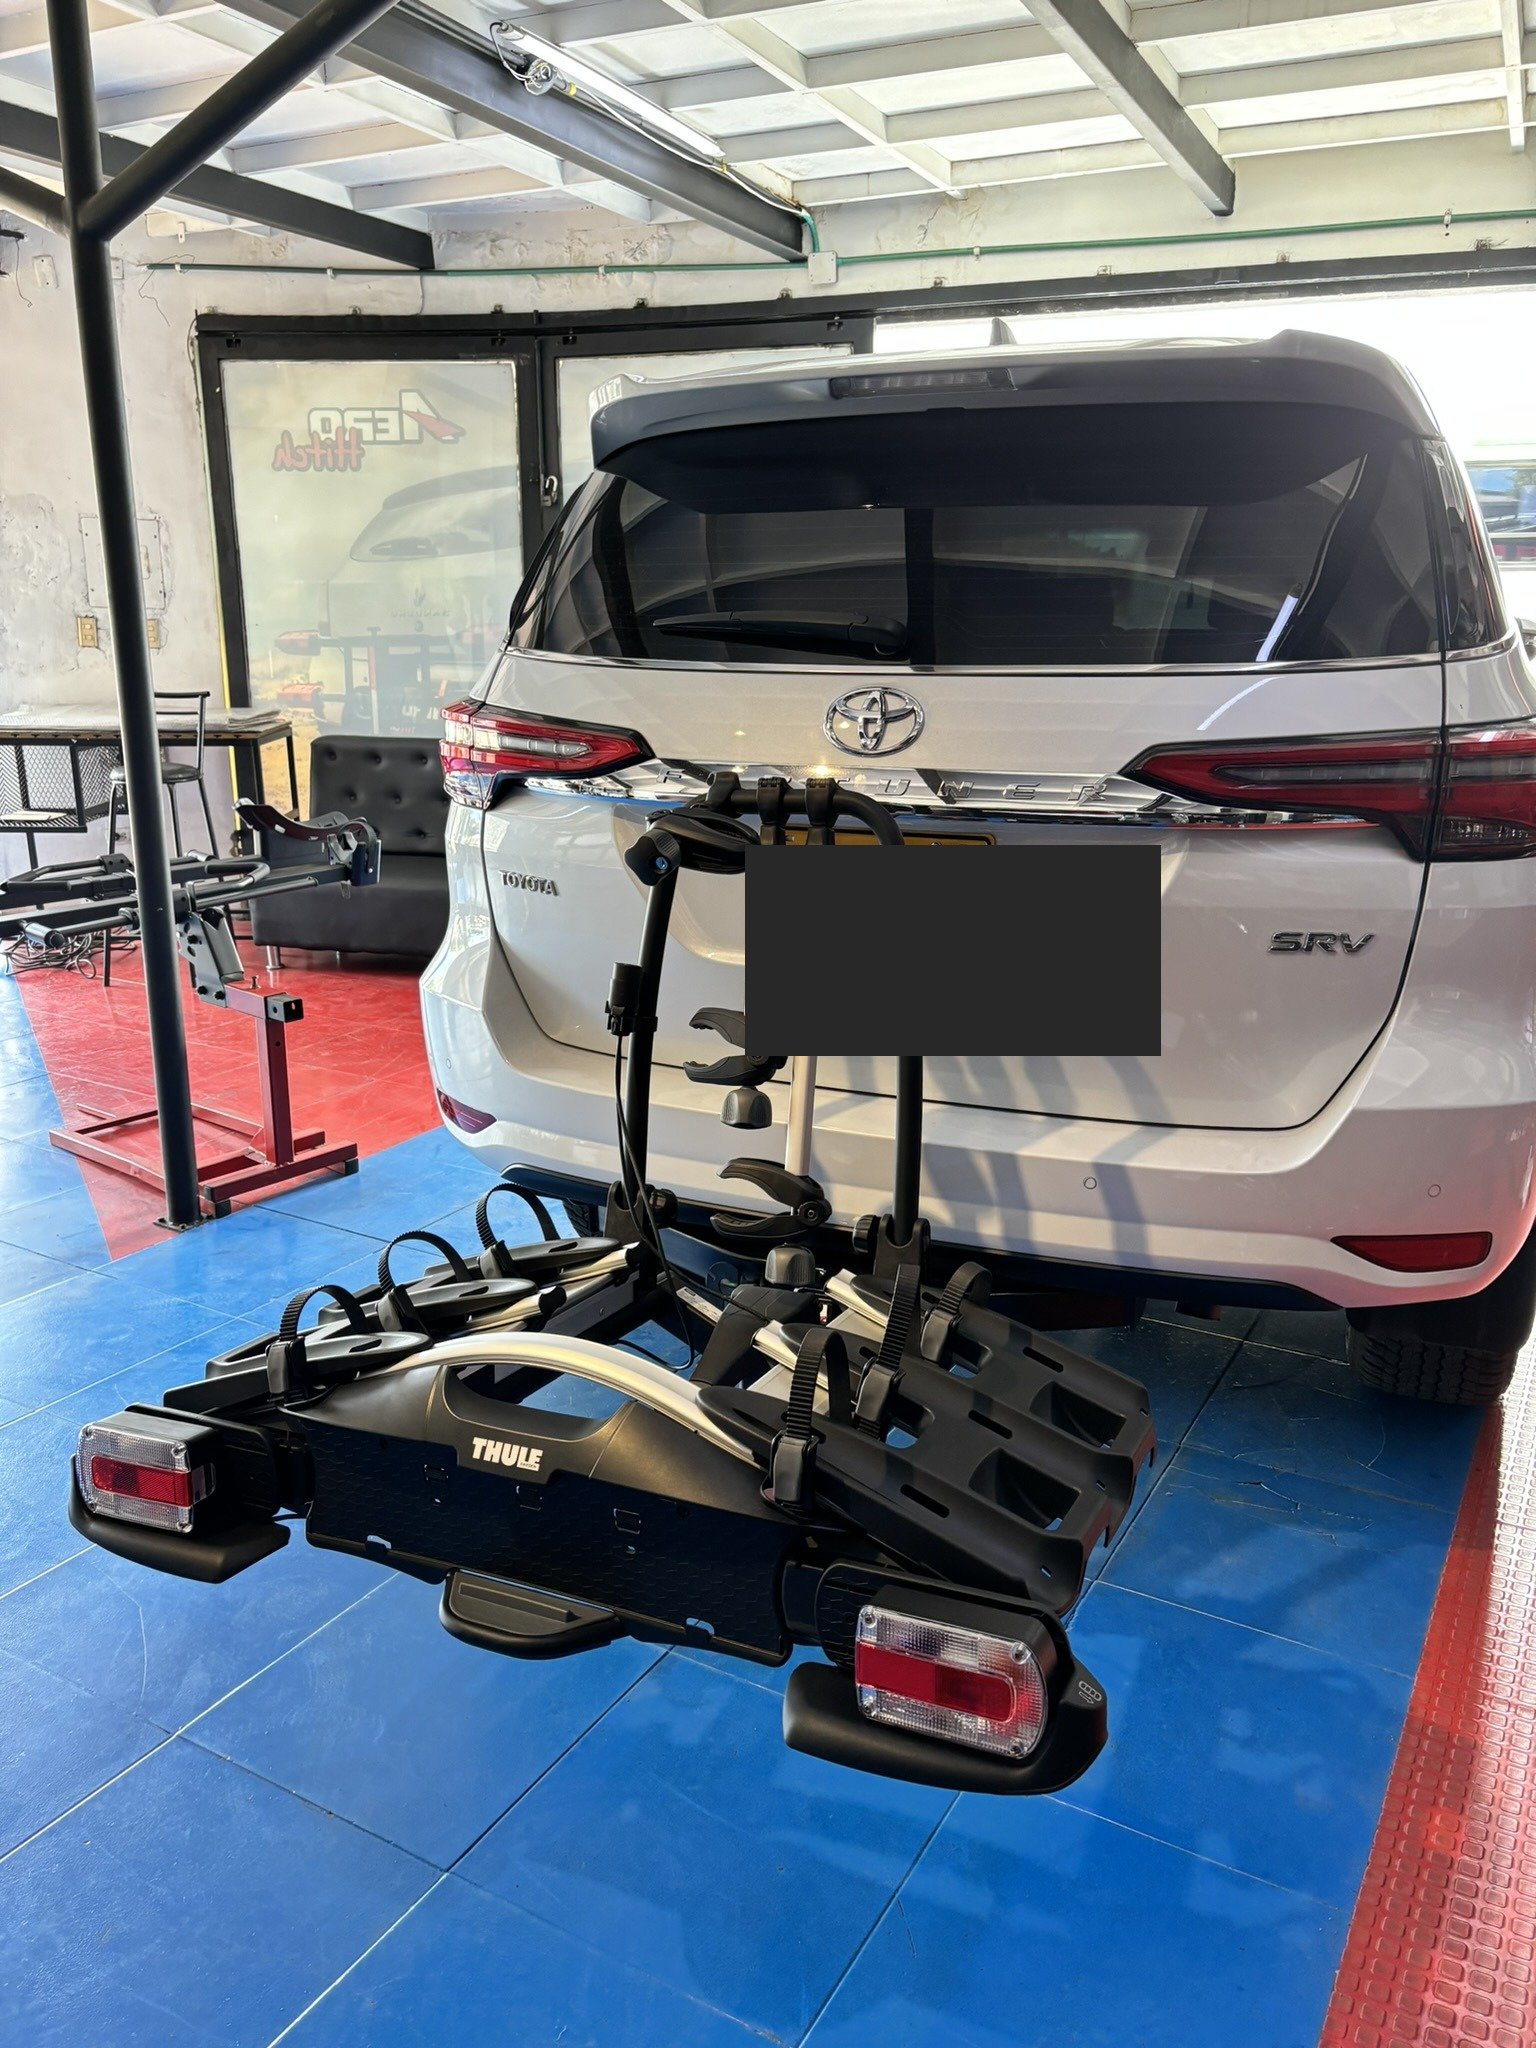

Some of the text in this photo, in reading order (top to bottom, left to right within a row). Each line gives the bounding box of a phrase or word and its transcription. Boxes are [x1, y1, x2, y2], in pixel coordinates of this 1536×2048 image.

[662, 769, 1108, 804] FUNER
[500, 870, 559, 896] TOYOTA
[1267, 931, 1376, 954] SRV
[472, 1436, 544, 1471] THULE
